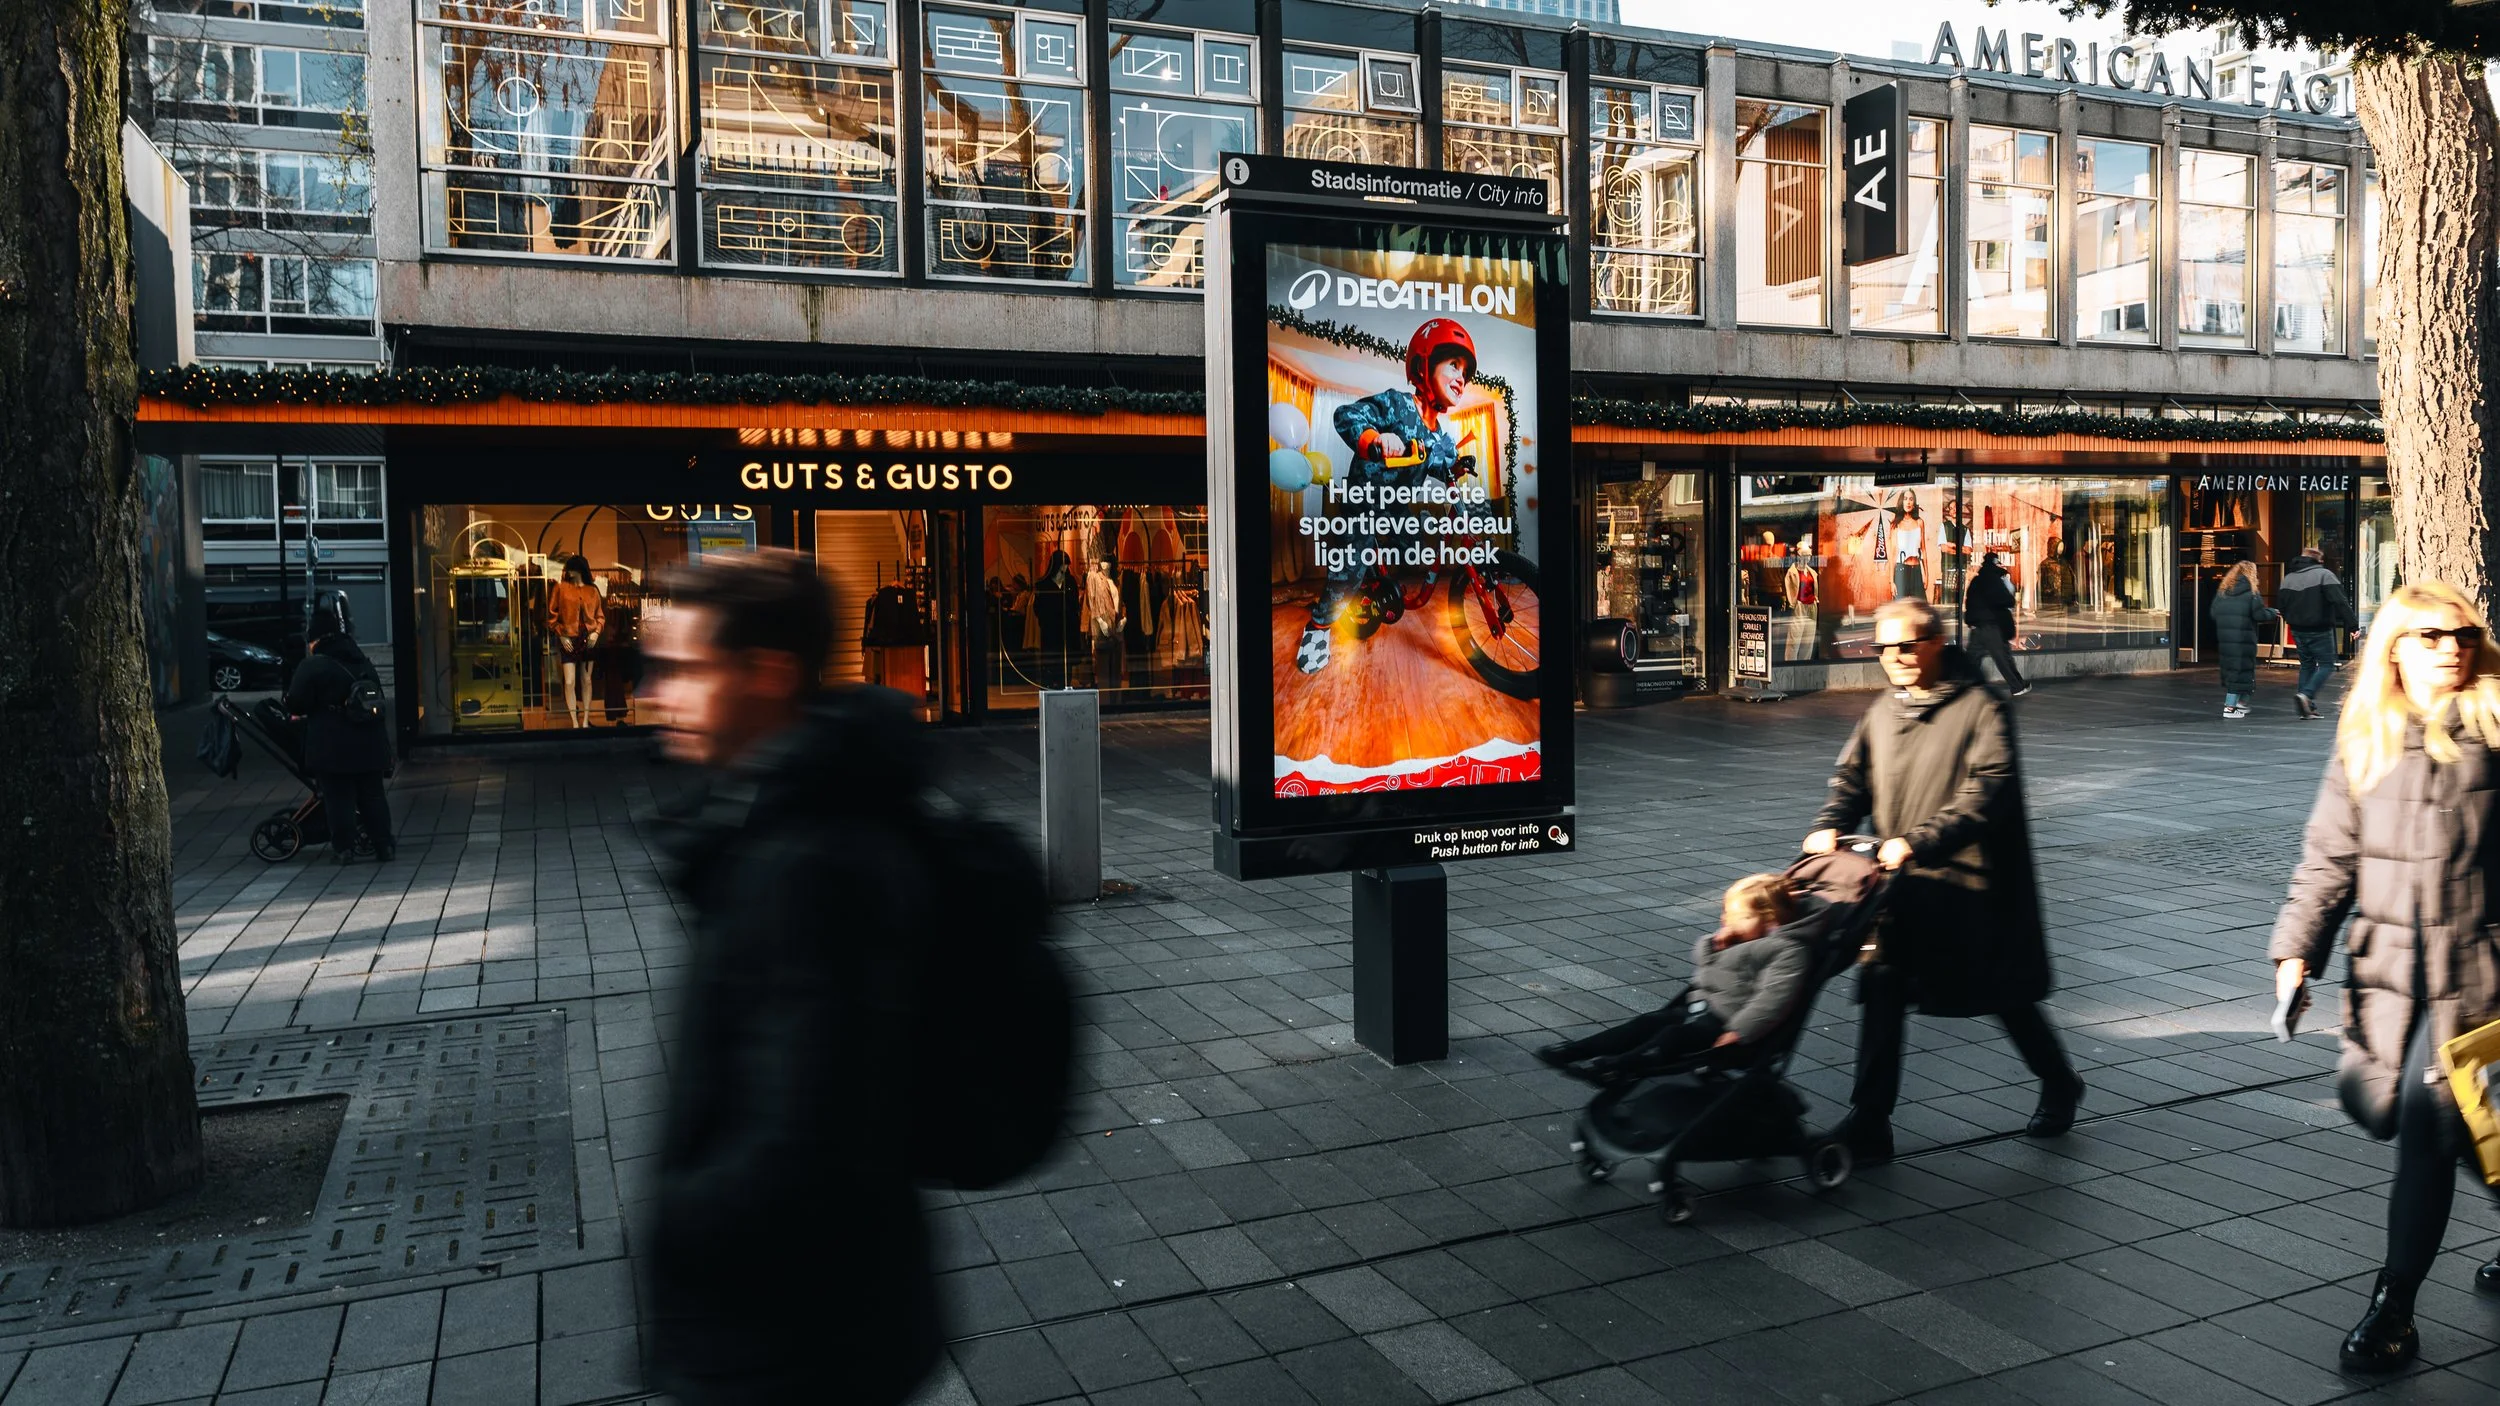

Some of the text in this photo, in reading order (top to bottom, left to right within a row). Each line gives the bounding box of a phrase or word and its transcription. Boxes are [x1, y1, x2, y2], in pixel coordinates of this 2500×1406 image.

[1929, 20, 2356, 118] AMERICAN EAGL
[1854, 129, 1887, 212] AE
[1311, 169, 1544, 207] Stadsinformatie / City info
[1337, 276, 1517, 316] DECATHLON
[741, 462, 1013, 490] GUTS & GUSTO
[2198, 474, 2349, 491] AMERICAN EAGLE
[1328, 478, 1485, 509] Het perfecte
[1299, 510, 1512, 540] sportieve cadeau
[1314, 540, 1500, 573] ligt om de hoek
[1758, 614, 1768, 622] STORE
[1414, 823, 1540, 844] Druk op knop voor info
[1431, 838, 1540, 858] Push button for info
